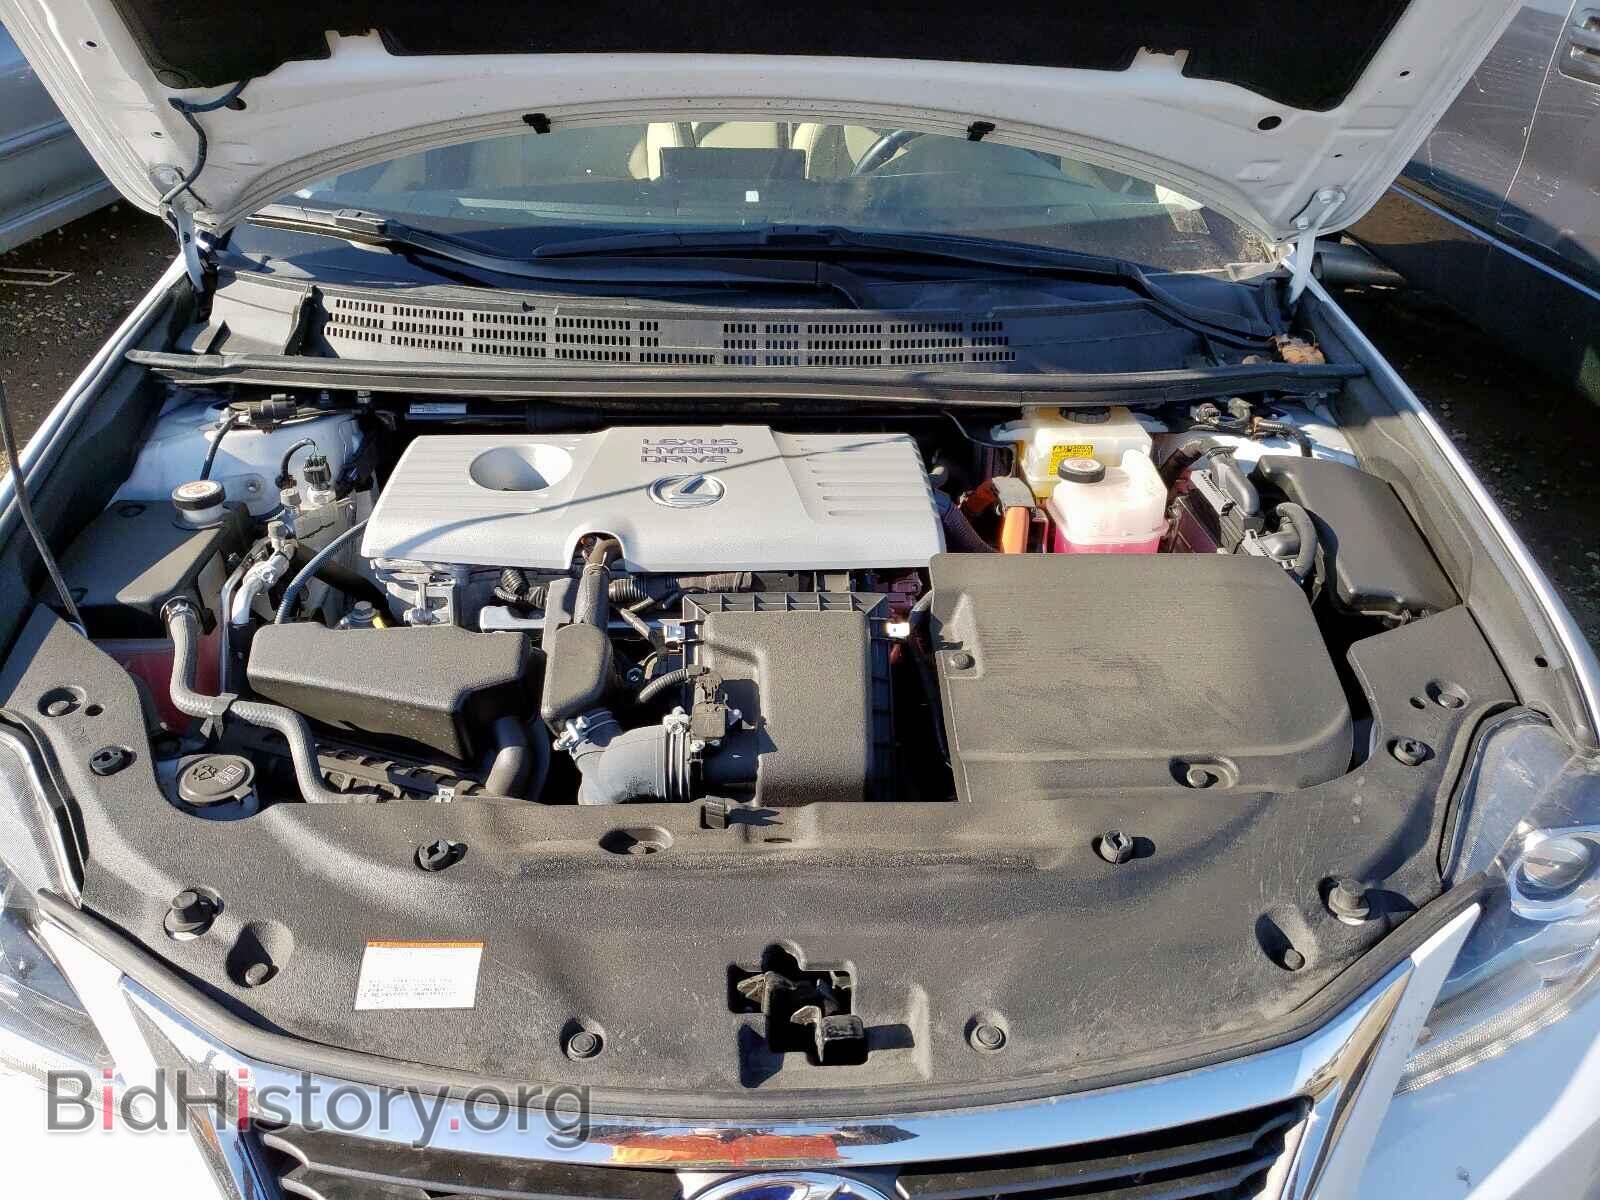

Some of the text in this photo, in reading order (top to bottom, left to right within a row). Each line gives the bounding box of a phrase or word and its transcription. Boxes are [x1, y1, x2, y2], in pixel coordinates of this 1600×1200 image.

[642, 438, 738, 446] LEXUS
[641, 446, 744, 455] HYBRID
[640, 455, 729, 464] DRIVE
